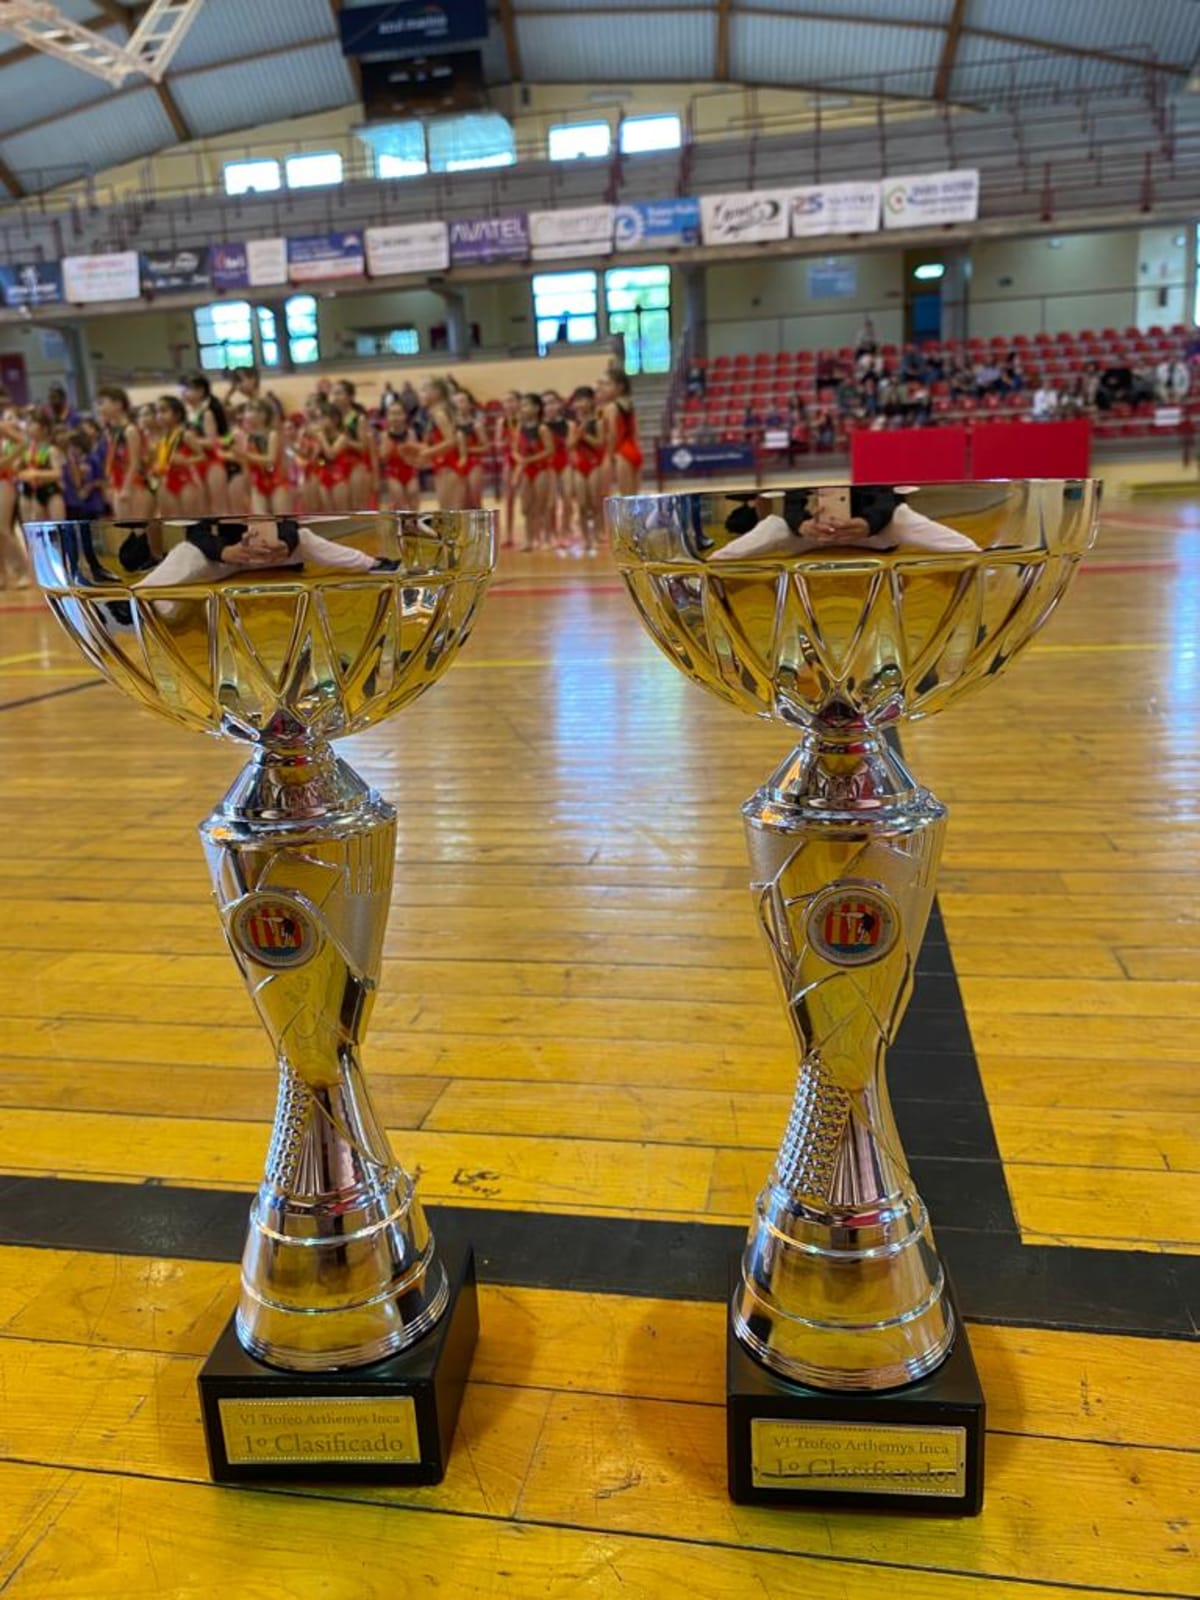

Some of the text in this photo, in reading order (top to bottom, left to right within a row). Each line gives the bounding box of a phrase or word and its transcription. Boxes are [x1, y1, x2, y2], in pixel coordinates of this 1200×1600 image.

[451, 215, 526, 243] AVATEL
[240, 1412, 400, 1428] VI Trofeo Arthemys Inca
[274, 1432, 403, 1454] Clasificado
[773, 1436, 949, 1456] VI Trofeo Arthemys Inca
[807, 1457, 950, 1485] Clasificado
